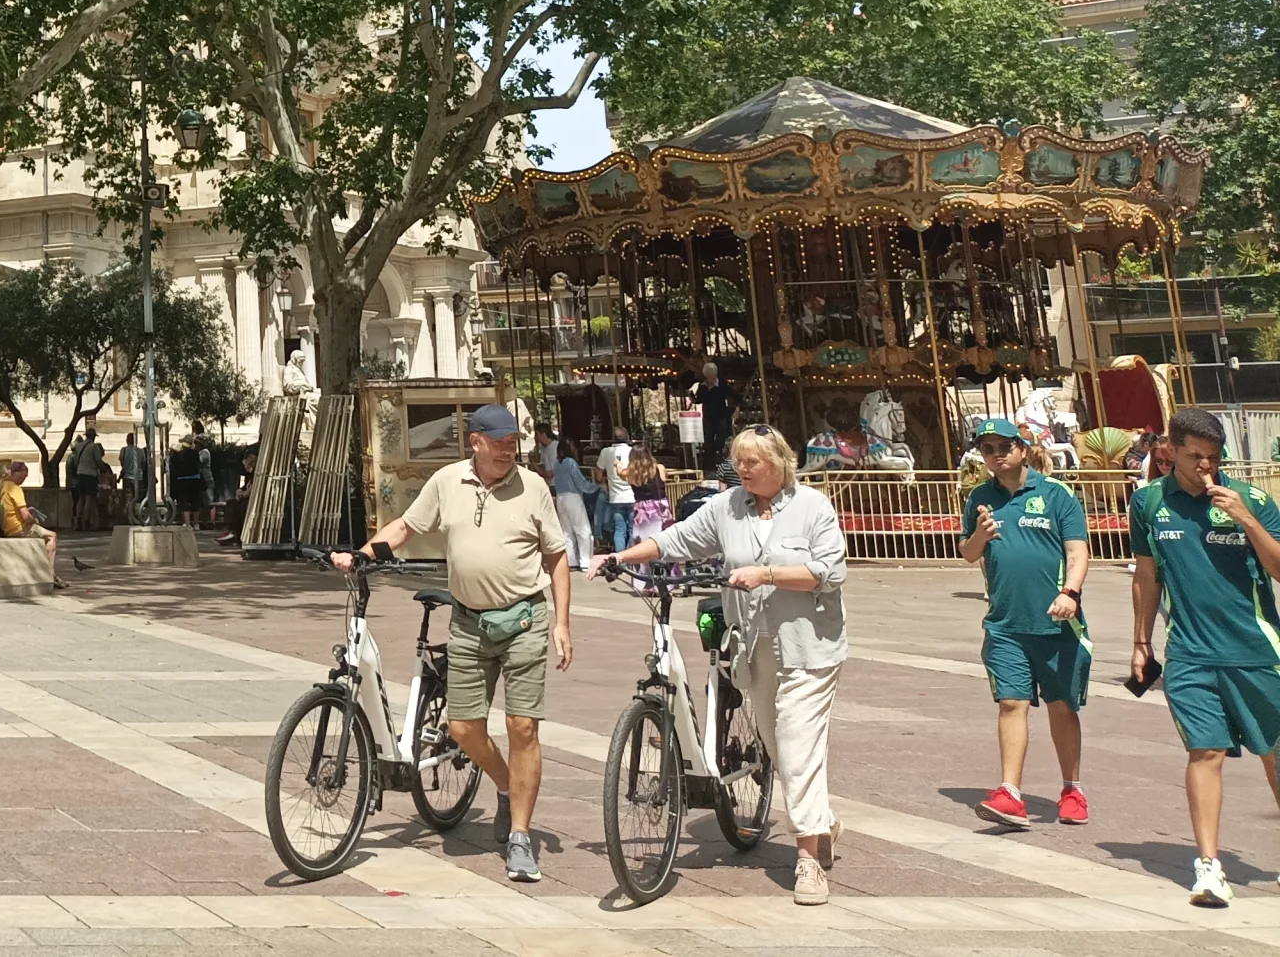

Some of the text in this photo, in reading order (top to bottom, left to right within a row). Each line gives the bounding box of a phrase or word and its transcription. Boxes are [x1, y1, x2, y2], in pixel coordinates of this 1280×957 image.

[1018, 516, 1051, 530] Coca-Cola
[1159, 530, 1184, 540] AT&T
[1206, 530, 1247, 545] Coca-Cola
